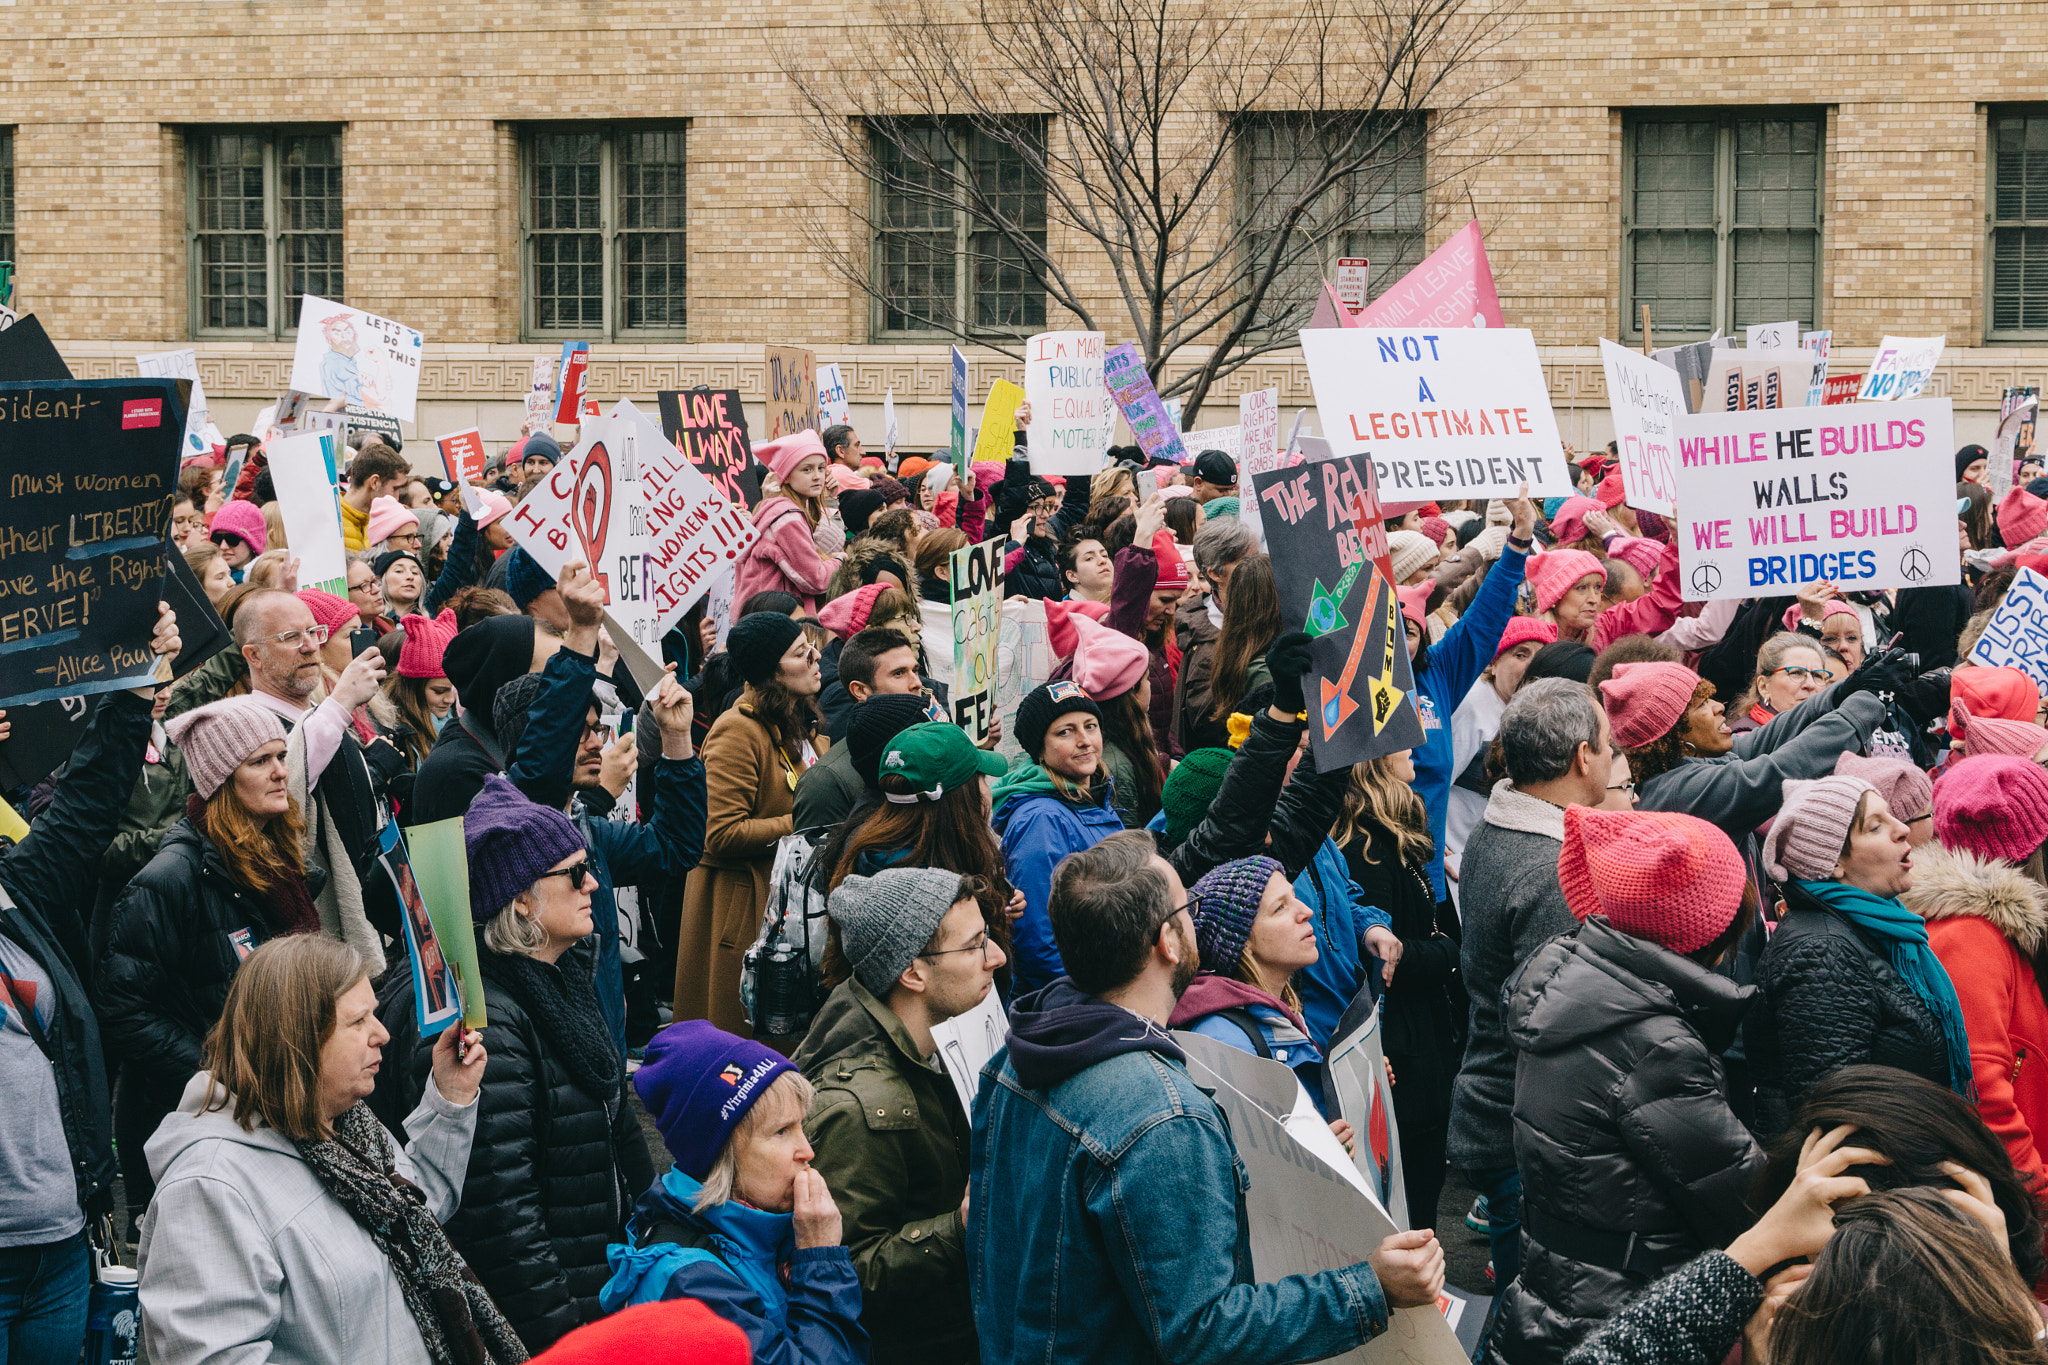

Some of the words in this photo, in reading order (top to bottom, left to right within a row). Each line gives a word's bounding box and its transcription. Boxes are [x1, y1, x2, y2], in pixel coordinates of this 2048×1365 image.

[1416, 245, 1475, 298] LEAVE
[366, 315, 401, 336] LET'S
[383, 334, 398, 346] DO
[1756, 329, 1781, 350] THIS
[388, 349, 416, 368] THIS
[1377, 335, 1439, 362] NOT
[819, 367, 846, 405] each
[1050, 366, 1092, 388] PUBLIC
[1419, 376, 1436, 402] A
[1615, 360, 1648, 409] Make
[1863, 374, 1896, 397] NO
[677, 393, 733, 429] LOVE
[1053, 397, 1096, 419] EQUAL
[1249, 391, 1268, 411] OUR
[1243, 406, 1277, 430] RIGHTS
[1244, 429, 1261, 446] ARE
[1263, 423, 1278, 440] NOT
[1350, 407, 1533, 441] LEGITIMATE
[675, 426, 748, 472] ALWAYS
[1053, 427, 1096, 449] MOTHER
[1245, 446, 1256, 460] UP
[1259, 440, 1273, 455] FOR
[1679, 432, 1768, 468] WHILE
[1775, 428, 1814, 459] HE
[1819, 419, 1926, 456] BUILDS
[1247, 455, 1275, 476] GRABS
[1374, 456, 1543, 489] PRESIDENT
[1624, 435, 1677, 503] FACTS
[75, 473, 163, 493] women
[1261, 471, 1318, 525] THE
[1753, 471, 1848, 509] WALLS
[69, 494, 176, 547] LIBERTY?
[651, 493, 723, 570] WOMEN'S
[1692, 519, 1733, 551] WE
[1748, 513, 1817, 546] WILL
[1830, 504, 1918, 539] BUILD
[47, 562, 95, 593] the
[952, 539, 1005, 600] LOVE
[1748, 550, 1876, 587] BRIDGES
[1975, 568, 2043, 668] PUSSY
[720, 1058, 778, 1121] #Virginia4ALL
